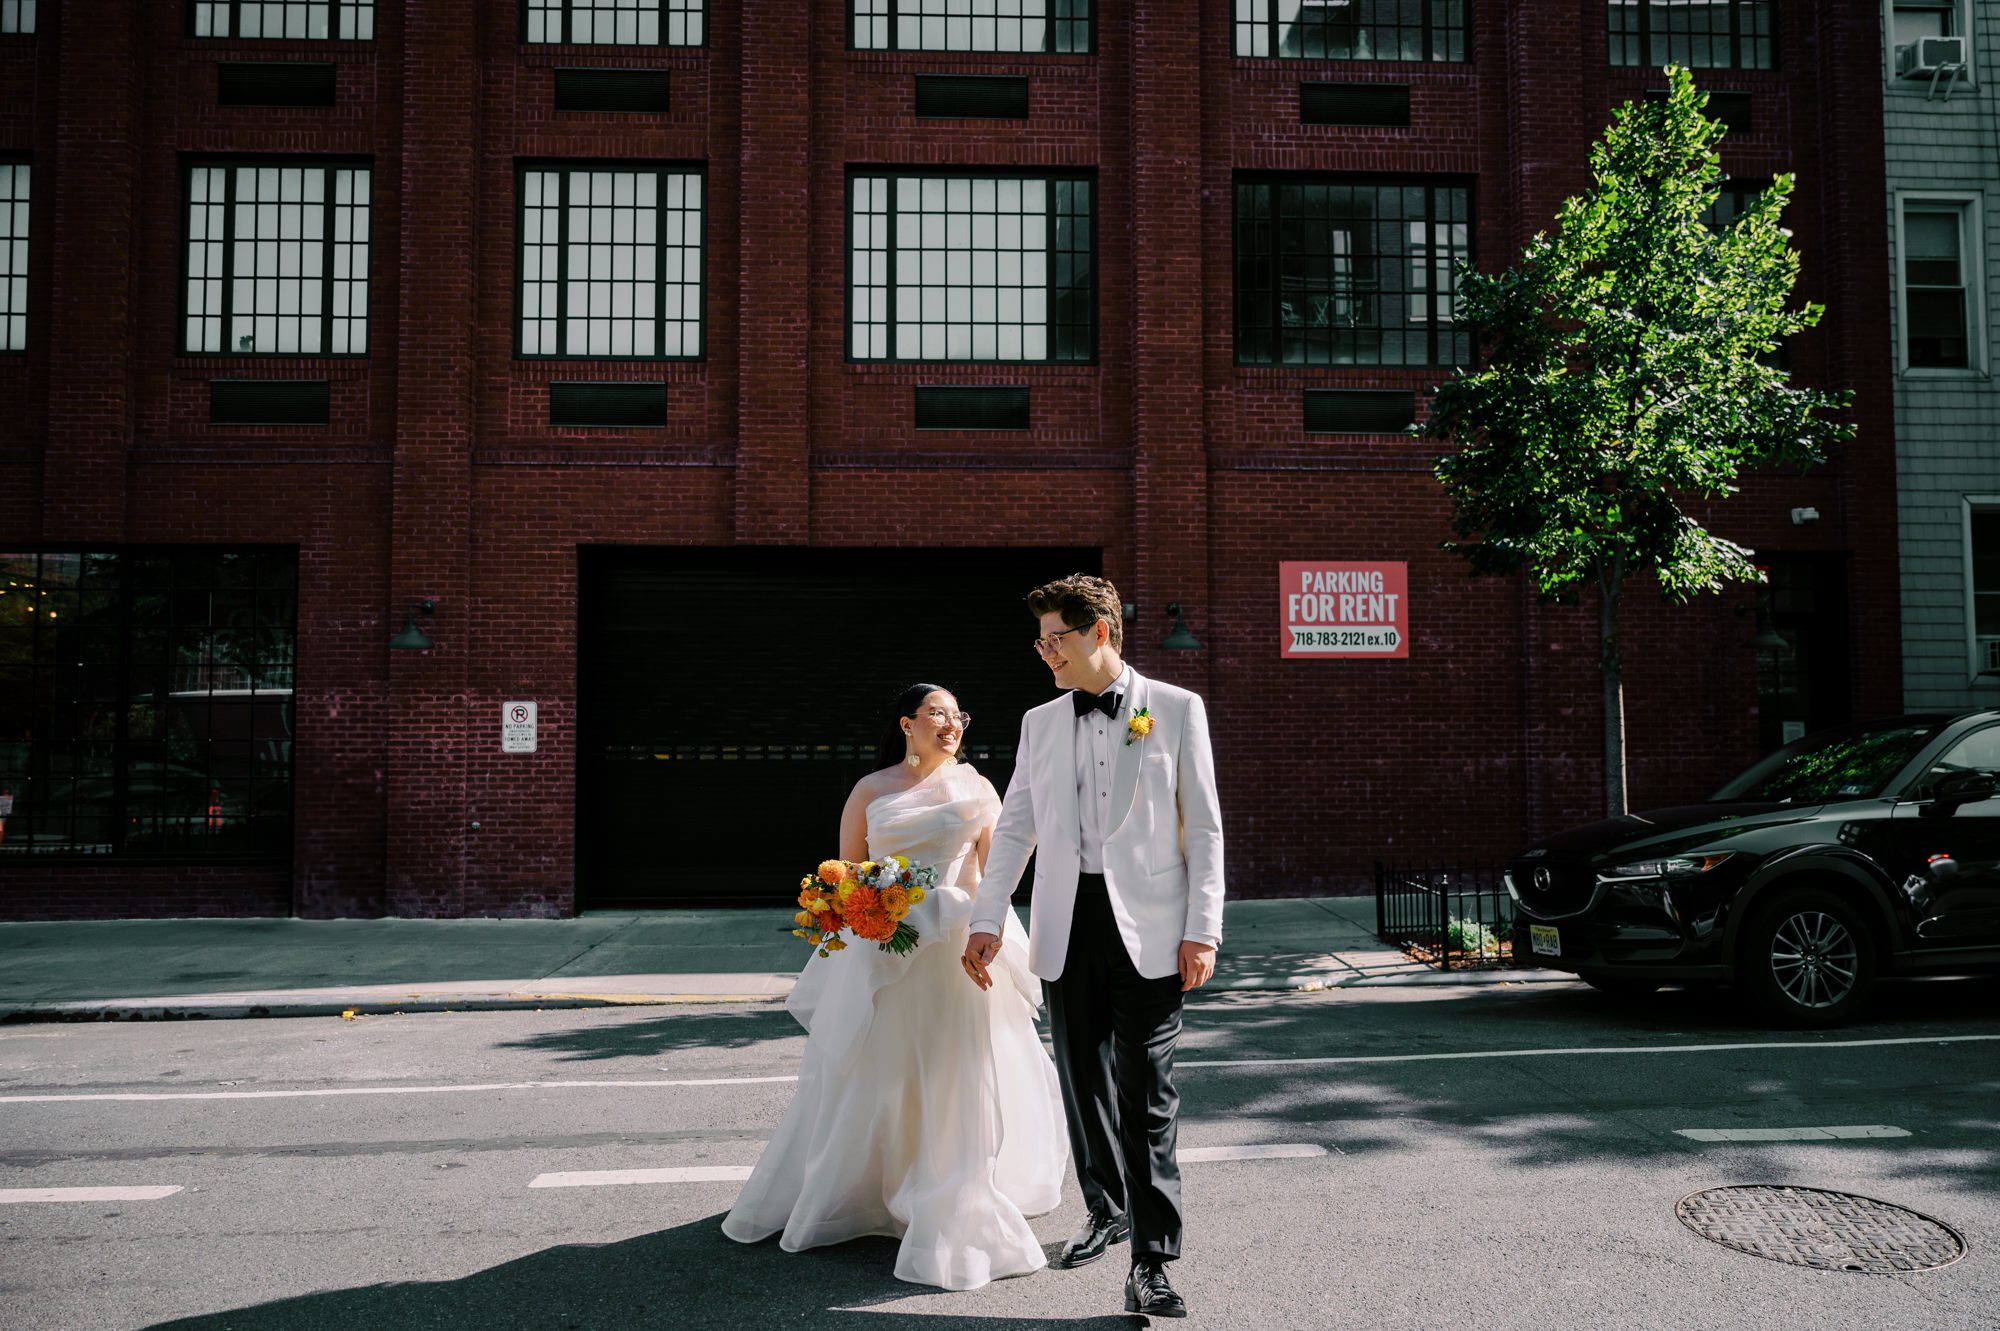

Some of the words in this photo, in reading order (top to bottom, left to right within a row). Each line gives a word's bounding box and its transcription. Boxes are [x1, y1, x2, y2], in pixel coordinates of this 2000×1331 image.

[1301, 571, 1383, 593] PARKING
[1288, 594, 1335, 622] FOR
[1339, 594, 1399, 622] RENT
[1295, 631, 1365, 646] 718-783-2121
[1367, 631, 1396, 646] ex.10
